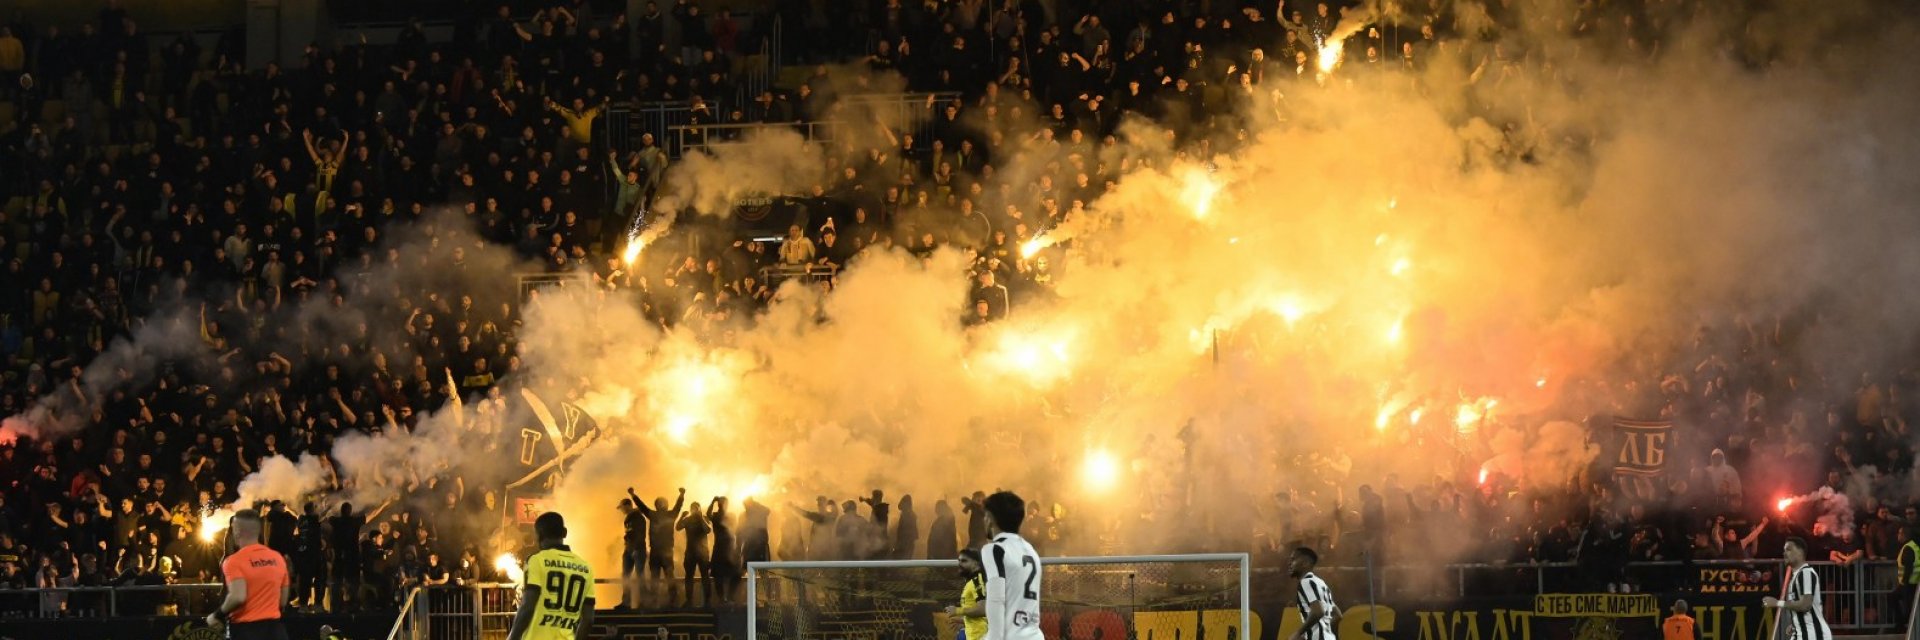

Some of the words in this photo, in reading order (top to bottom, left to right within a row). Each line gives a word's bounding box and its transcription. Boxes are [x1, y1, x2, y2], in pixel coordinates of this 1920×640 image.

[1022, 555, 1037, 600] 2
[1700, 569, 1742, 582] ГУСТ
[544, 571, 586, 613] 90
[1537, 596, 1544, 612] С
[1548, 597, 1571, 613] ТЕБ
